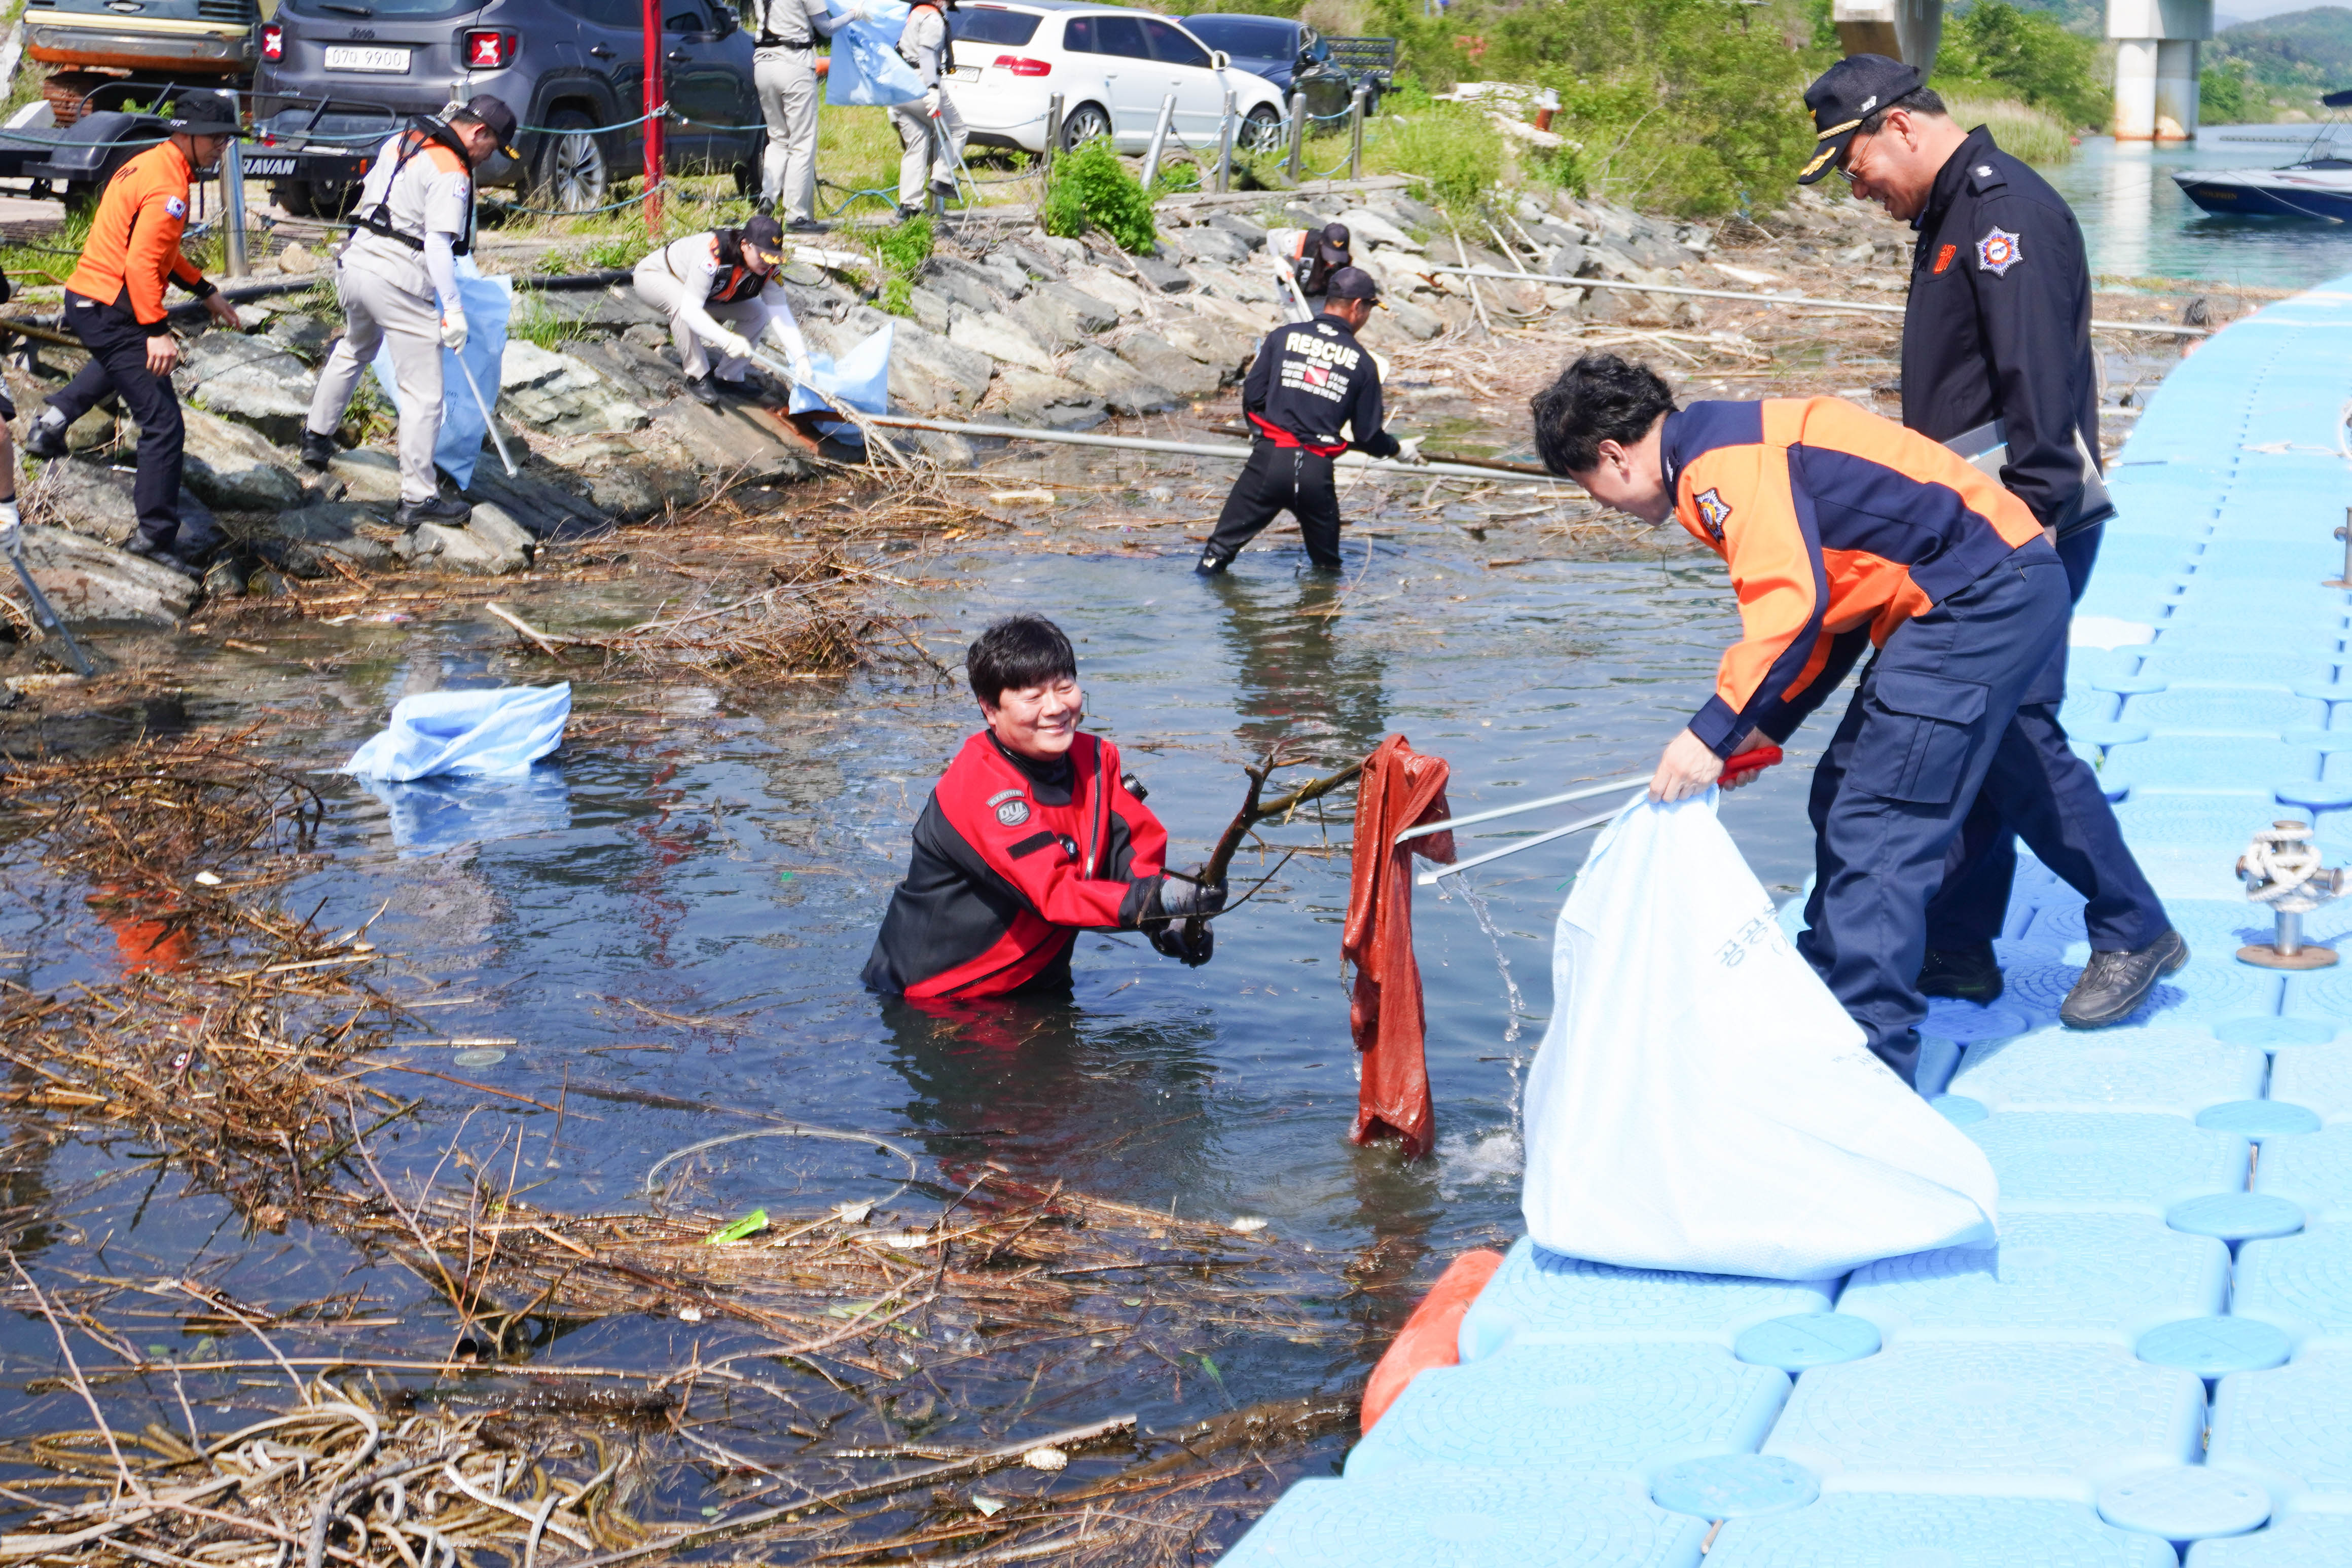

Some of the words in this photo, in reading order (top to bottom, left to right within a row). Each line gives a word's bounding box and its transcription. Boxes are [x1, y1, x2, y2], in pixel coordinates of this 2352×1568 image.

[365, 51, 401, 66] 9900
[213, 158, 297, 175] RAVAN
[1285, 332, 1360, 371] RESCUE
[999, 802, 1023, 820] DUI
